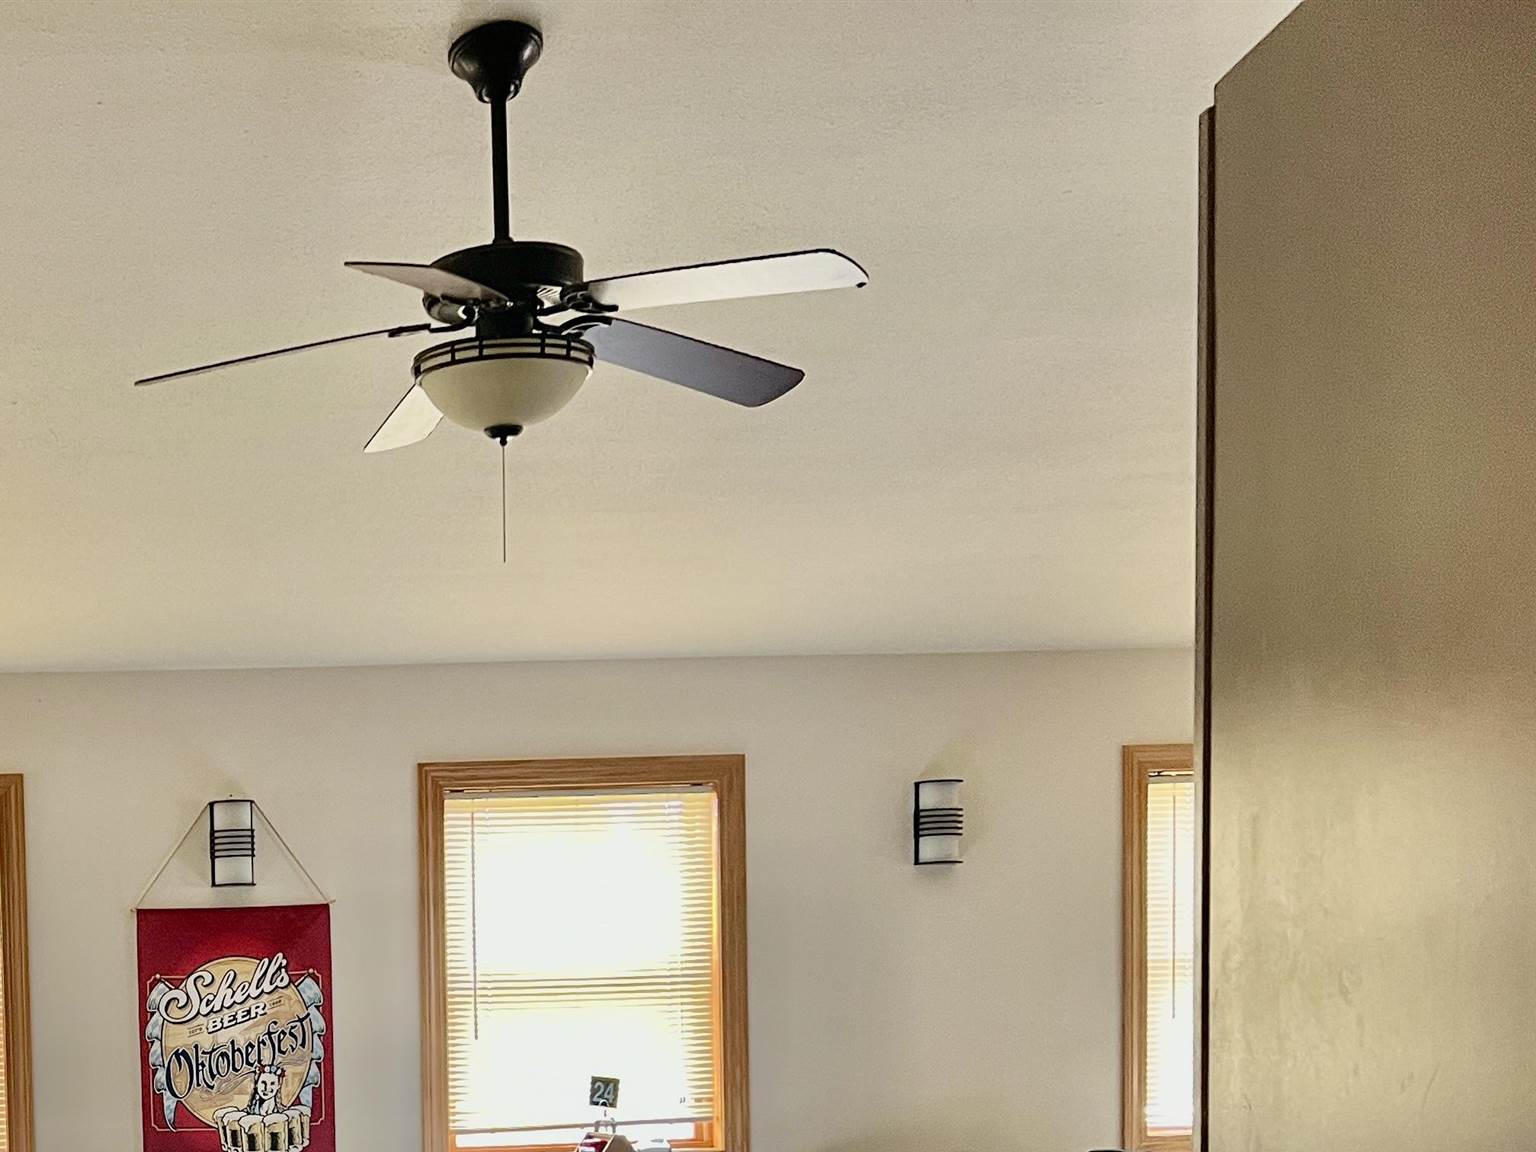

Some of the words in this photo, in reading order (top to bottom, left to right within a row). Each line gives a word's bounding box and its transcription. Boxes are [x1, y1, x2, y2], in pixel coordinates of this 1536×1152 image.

[158, 952, 290, 1024] Schell's
[206, 1001, 267, 1034] BEER
[165, 1012, 311, 1100] Oktoberfest
[591, 1081, 615, 1105] 24
